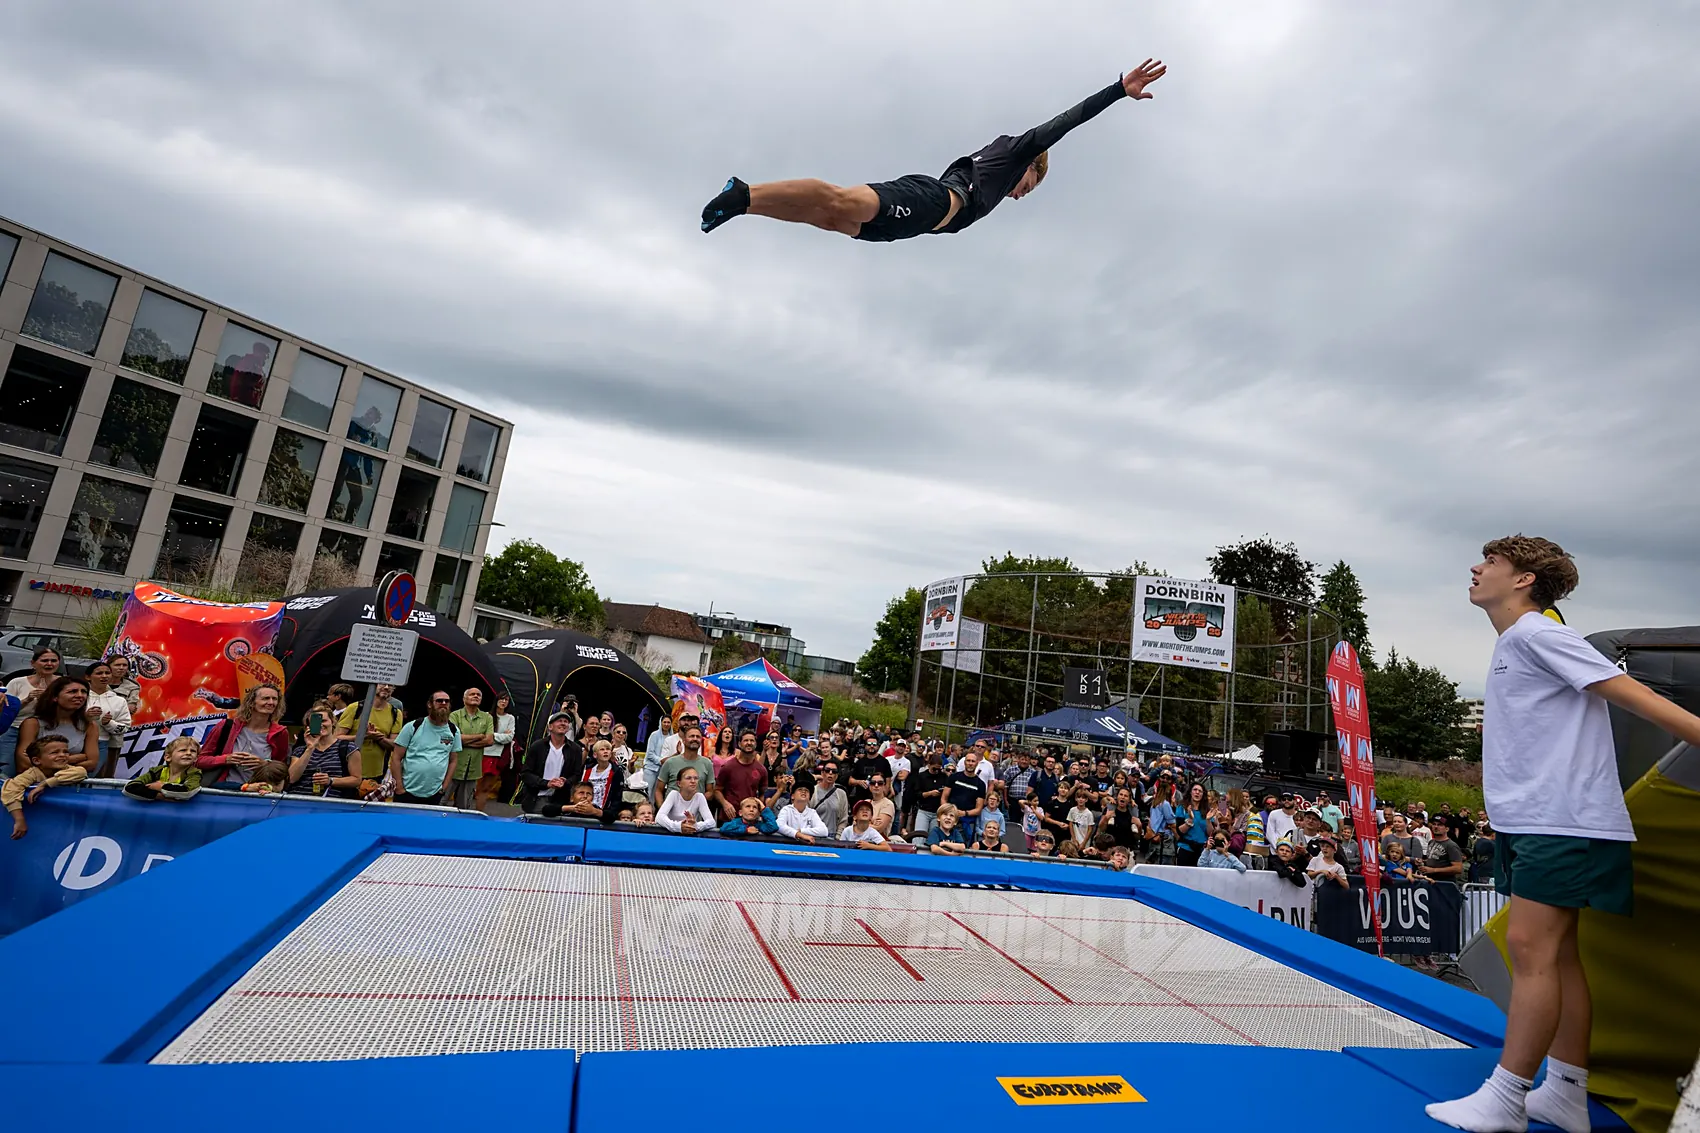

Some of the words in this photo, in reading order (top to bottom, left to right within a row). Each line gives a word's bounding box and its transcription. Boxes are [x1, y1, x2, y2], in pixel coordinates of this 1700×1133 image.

[1145, 585, 1225, 604] DORNBIRN
[575, 644, 605, 654] NIGHT
[1142, 639, 1226, 657] WWW.NIGHTOFTHEJUMPS.COM
[577, 650, 619, 662] JUMPS
[163, 712, 228, 726] CHAMPIONSHIP
[1397, 887, 1430, 930] ÜS
[1357, 936, 1365, 944] AUS
[1405, 935, 1415, 943] VON
[1012, 1082, 1123, 1099] EUROTRAMP
